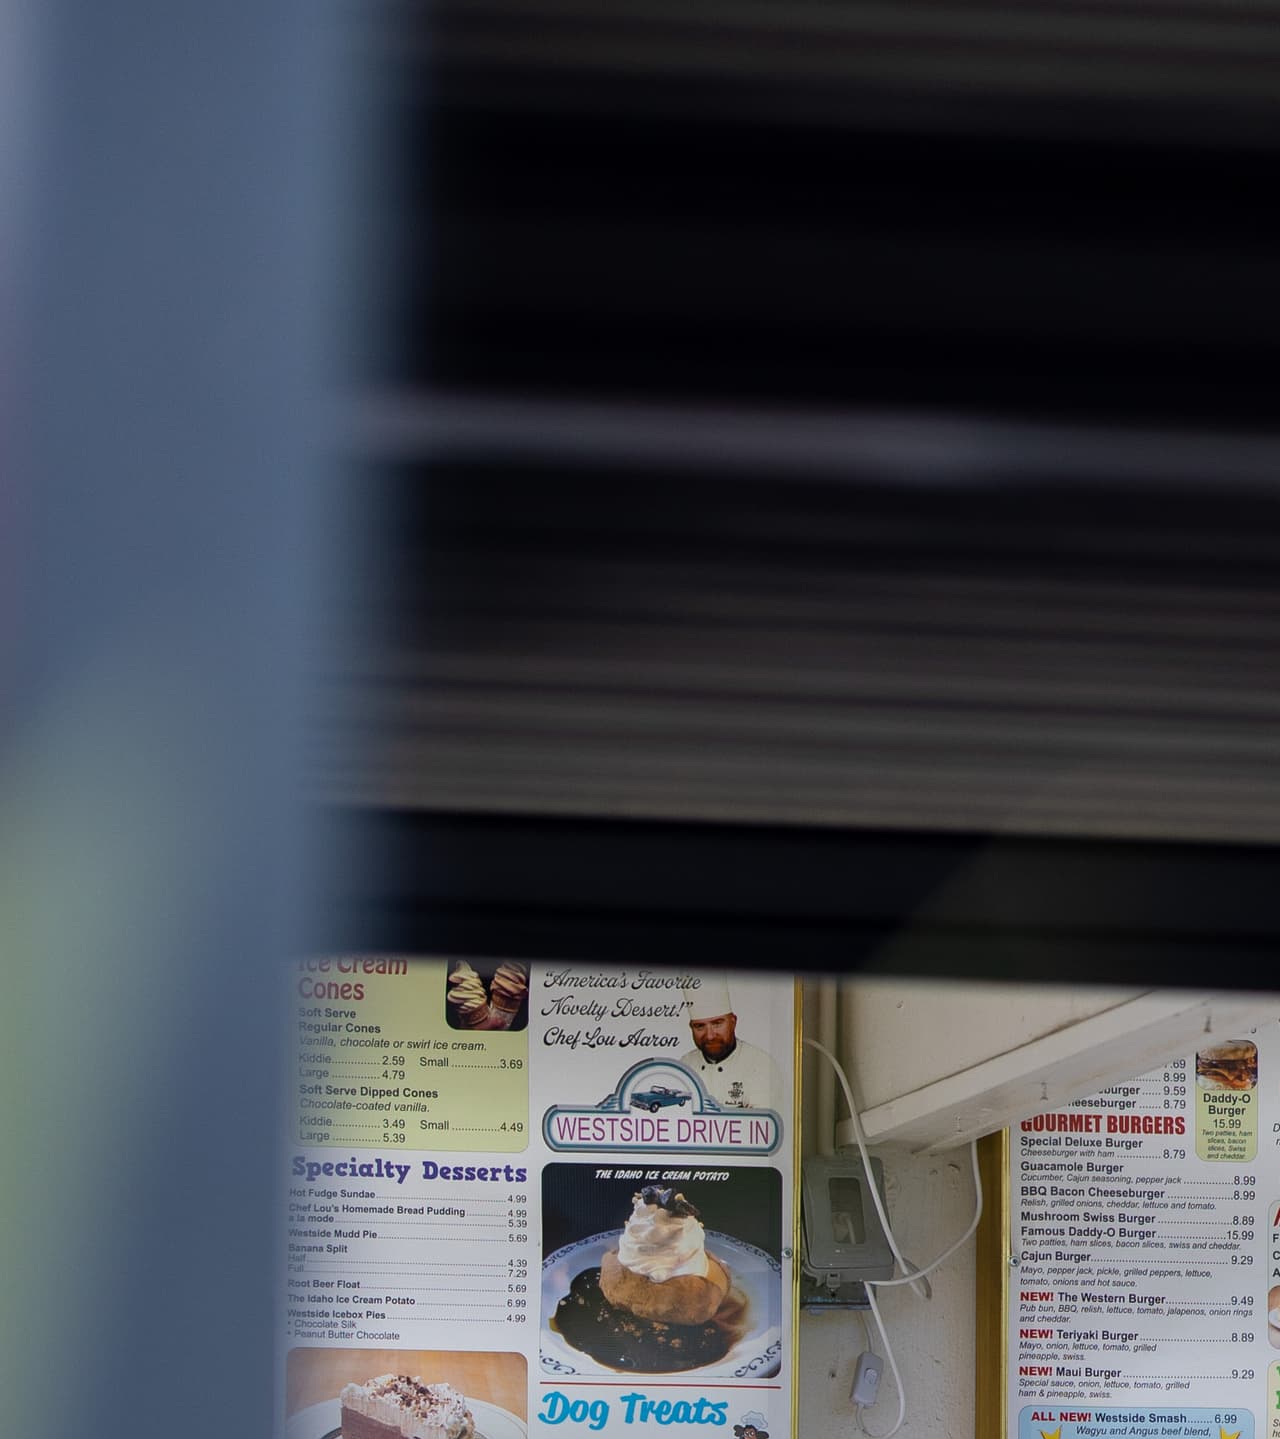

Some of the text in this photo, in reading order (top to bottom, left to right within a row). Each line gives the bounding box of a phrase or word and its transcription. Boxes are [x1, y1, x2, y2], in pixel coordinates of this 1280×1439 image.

[297, 976, 365, 1001] Cones
[631, 973, 700, 990] Favorite
[541, 995, 607, 1021] Novelty
[543, 1027, 680, 1050] Chef Lou Aaron
[556, 1116, 768, 1144] WESTSIDE DRIVE IN
[1106, 1114, 1186, 1136] BURGERS
[291, 1155, 527, 1185] Specialty Desserts
[595, 1169, 730, 1181] THE IDAHO ICE CREAM POTATO
[537, 1391, 728, 1430] Dog Treats
[1031, 1412, 1237, 1424] ALL NEW! Westside Smash 6.99
